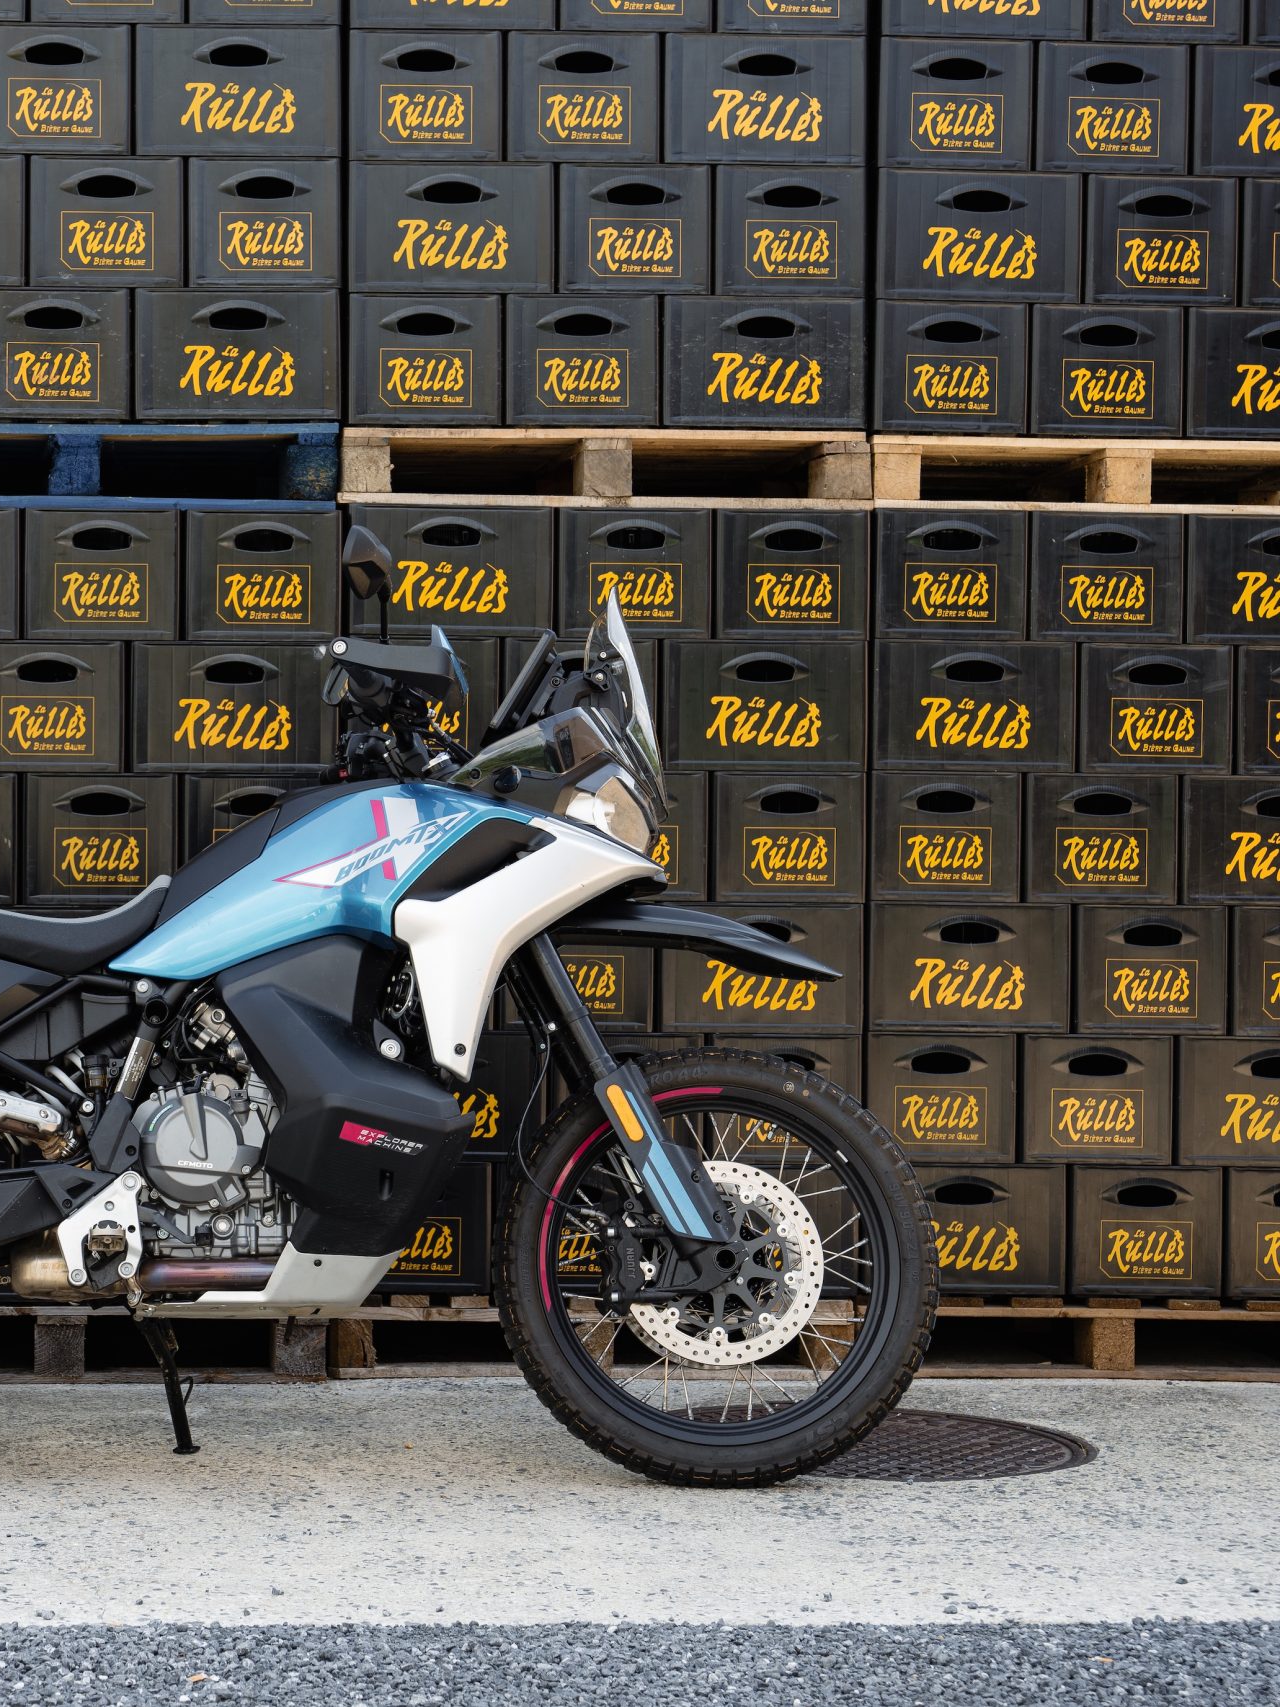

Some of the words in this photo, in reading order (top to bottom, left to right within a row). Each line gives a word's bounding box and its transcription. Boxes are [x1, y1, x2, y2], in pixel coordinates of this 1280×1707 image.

[357, 1135, 412, 1153] MACHINE
[360, 1129, 424, 1150] EXPLORER
[177, 1160, 214, 1169] CFMOTO
[931, 1221, 1020, 1272] ulles
